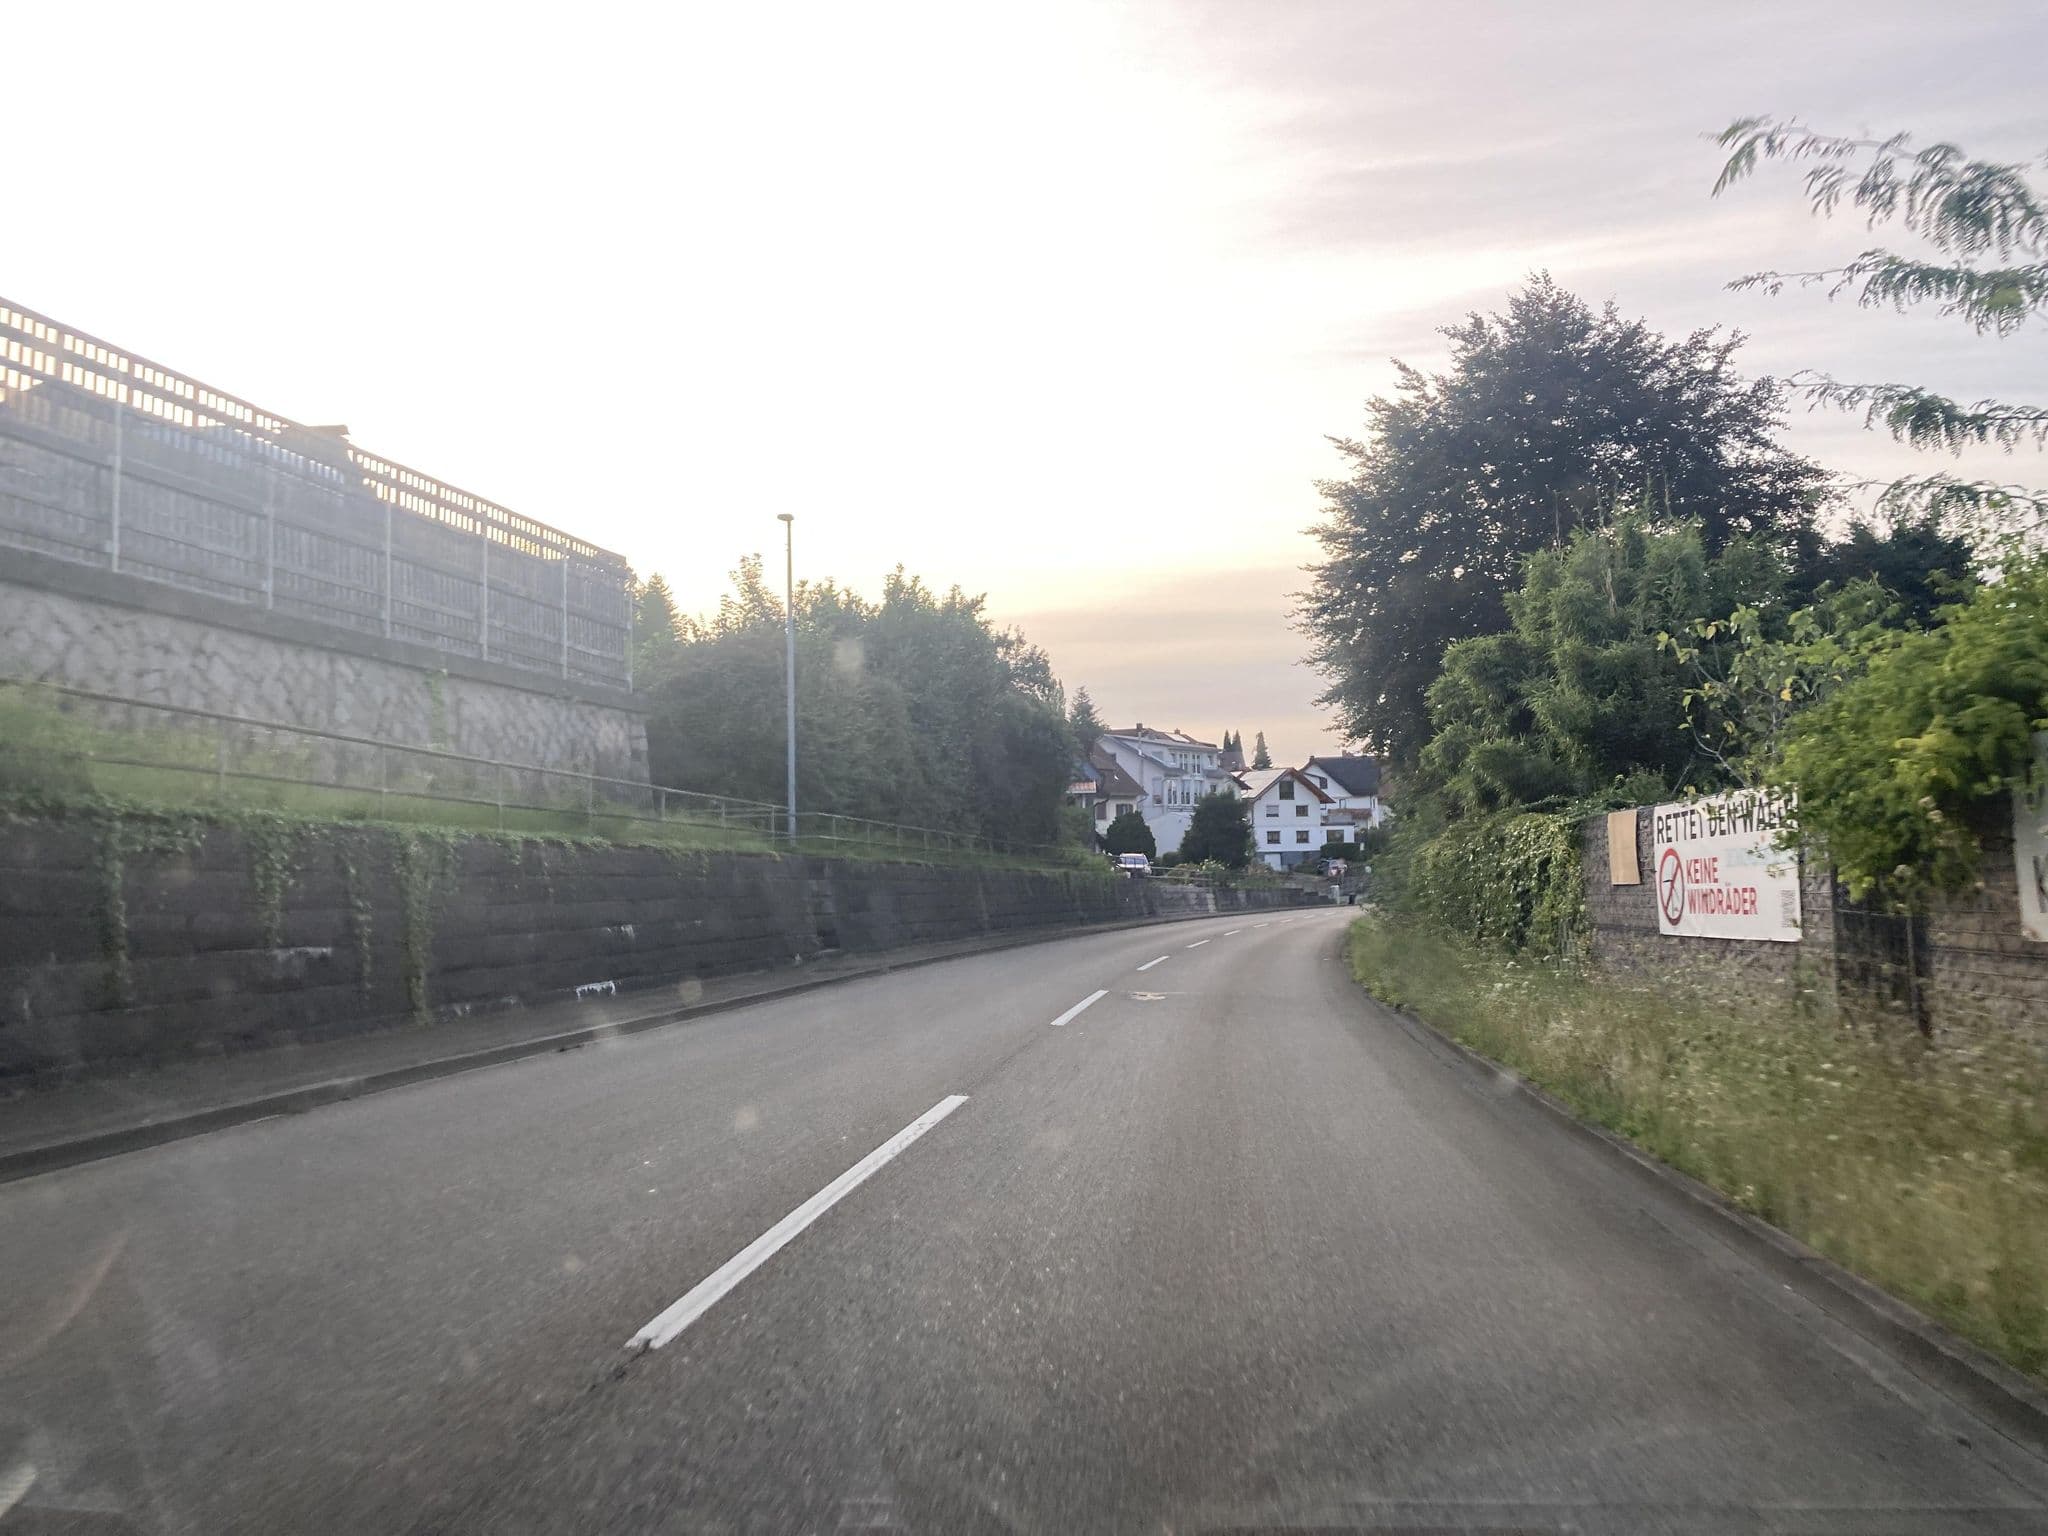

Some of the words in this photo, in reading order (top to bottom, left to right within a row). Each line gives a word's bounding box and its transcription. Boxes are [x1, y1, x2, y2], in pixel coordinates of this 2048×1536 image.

[1657, 807, 1705, 844] RETTET
[1706, 802, 1737, 837] DEN
[1686, 857, 1718, 884] KEINE
[1687, 882, 1758, 915] WINDRÄDER
